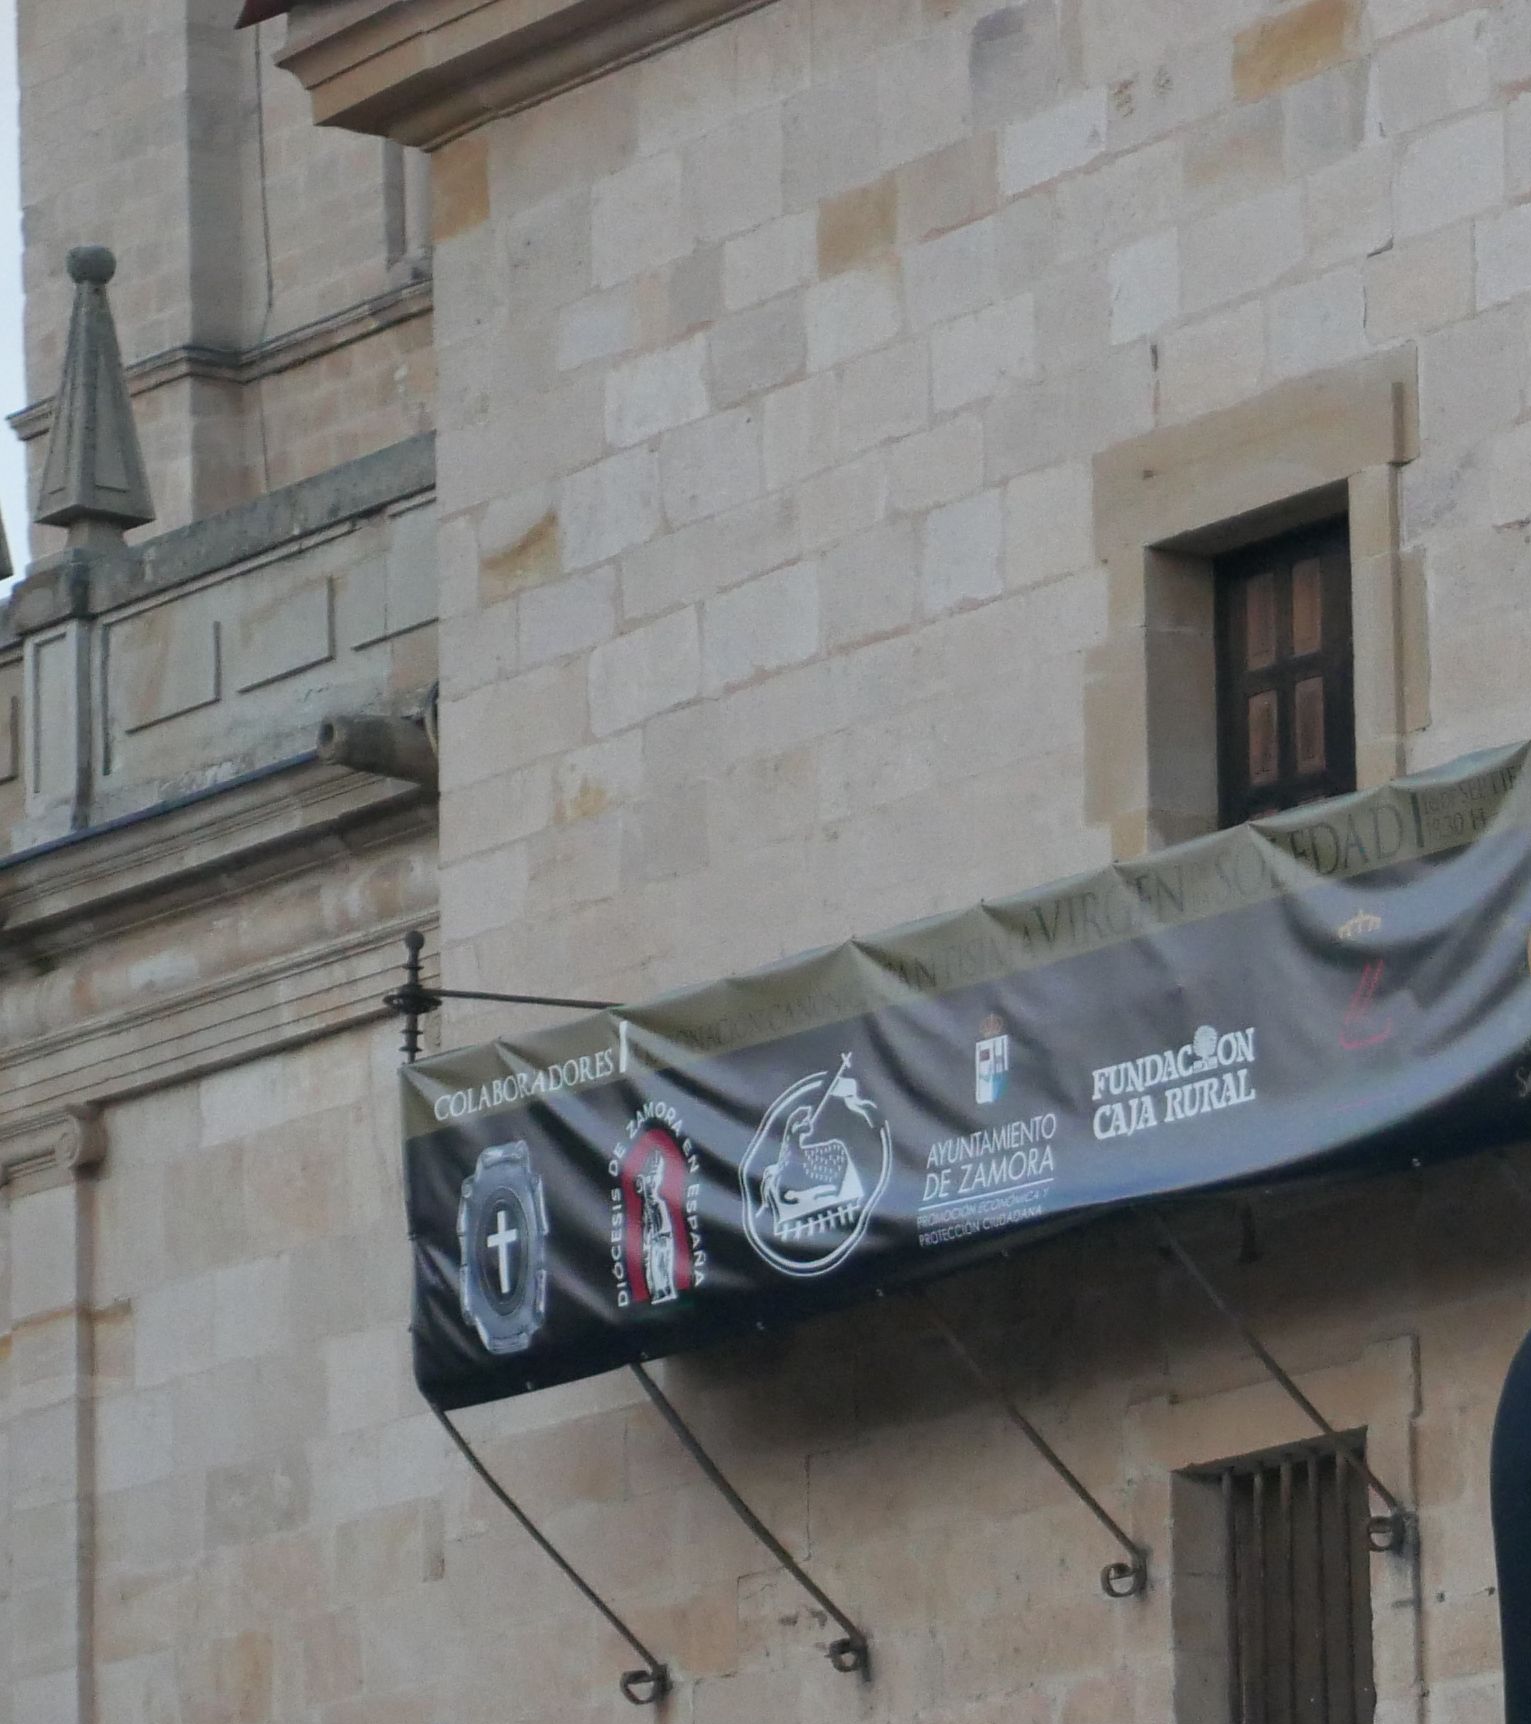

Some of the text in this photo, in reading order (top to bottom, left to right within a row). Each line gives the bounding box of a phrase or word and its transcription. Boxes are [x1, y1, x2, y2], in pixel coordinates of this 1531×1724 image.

[433, 1048, 615, 1122] COLABORADORES
[1092, 1068, 1256, 1140] CAJA RURAL
[922, 1144, 1054, 1202] DE ZAMORA
[926, 1112, 1057, 1170] AYUNTAMIENTO
[608, 1101, 707, 1307] DIÓCESIS DE ZAMORA EN ESPAÑA
[982, 1204, 1043, 1231] CIUDADANA
